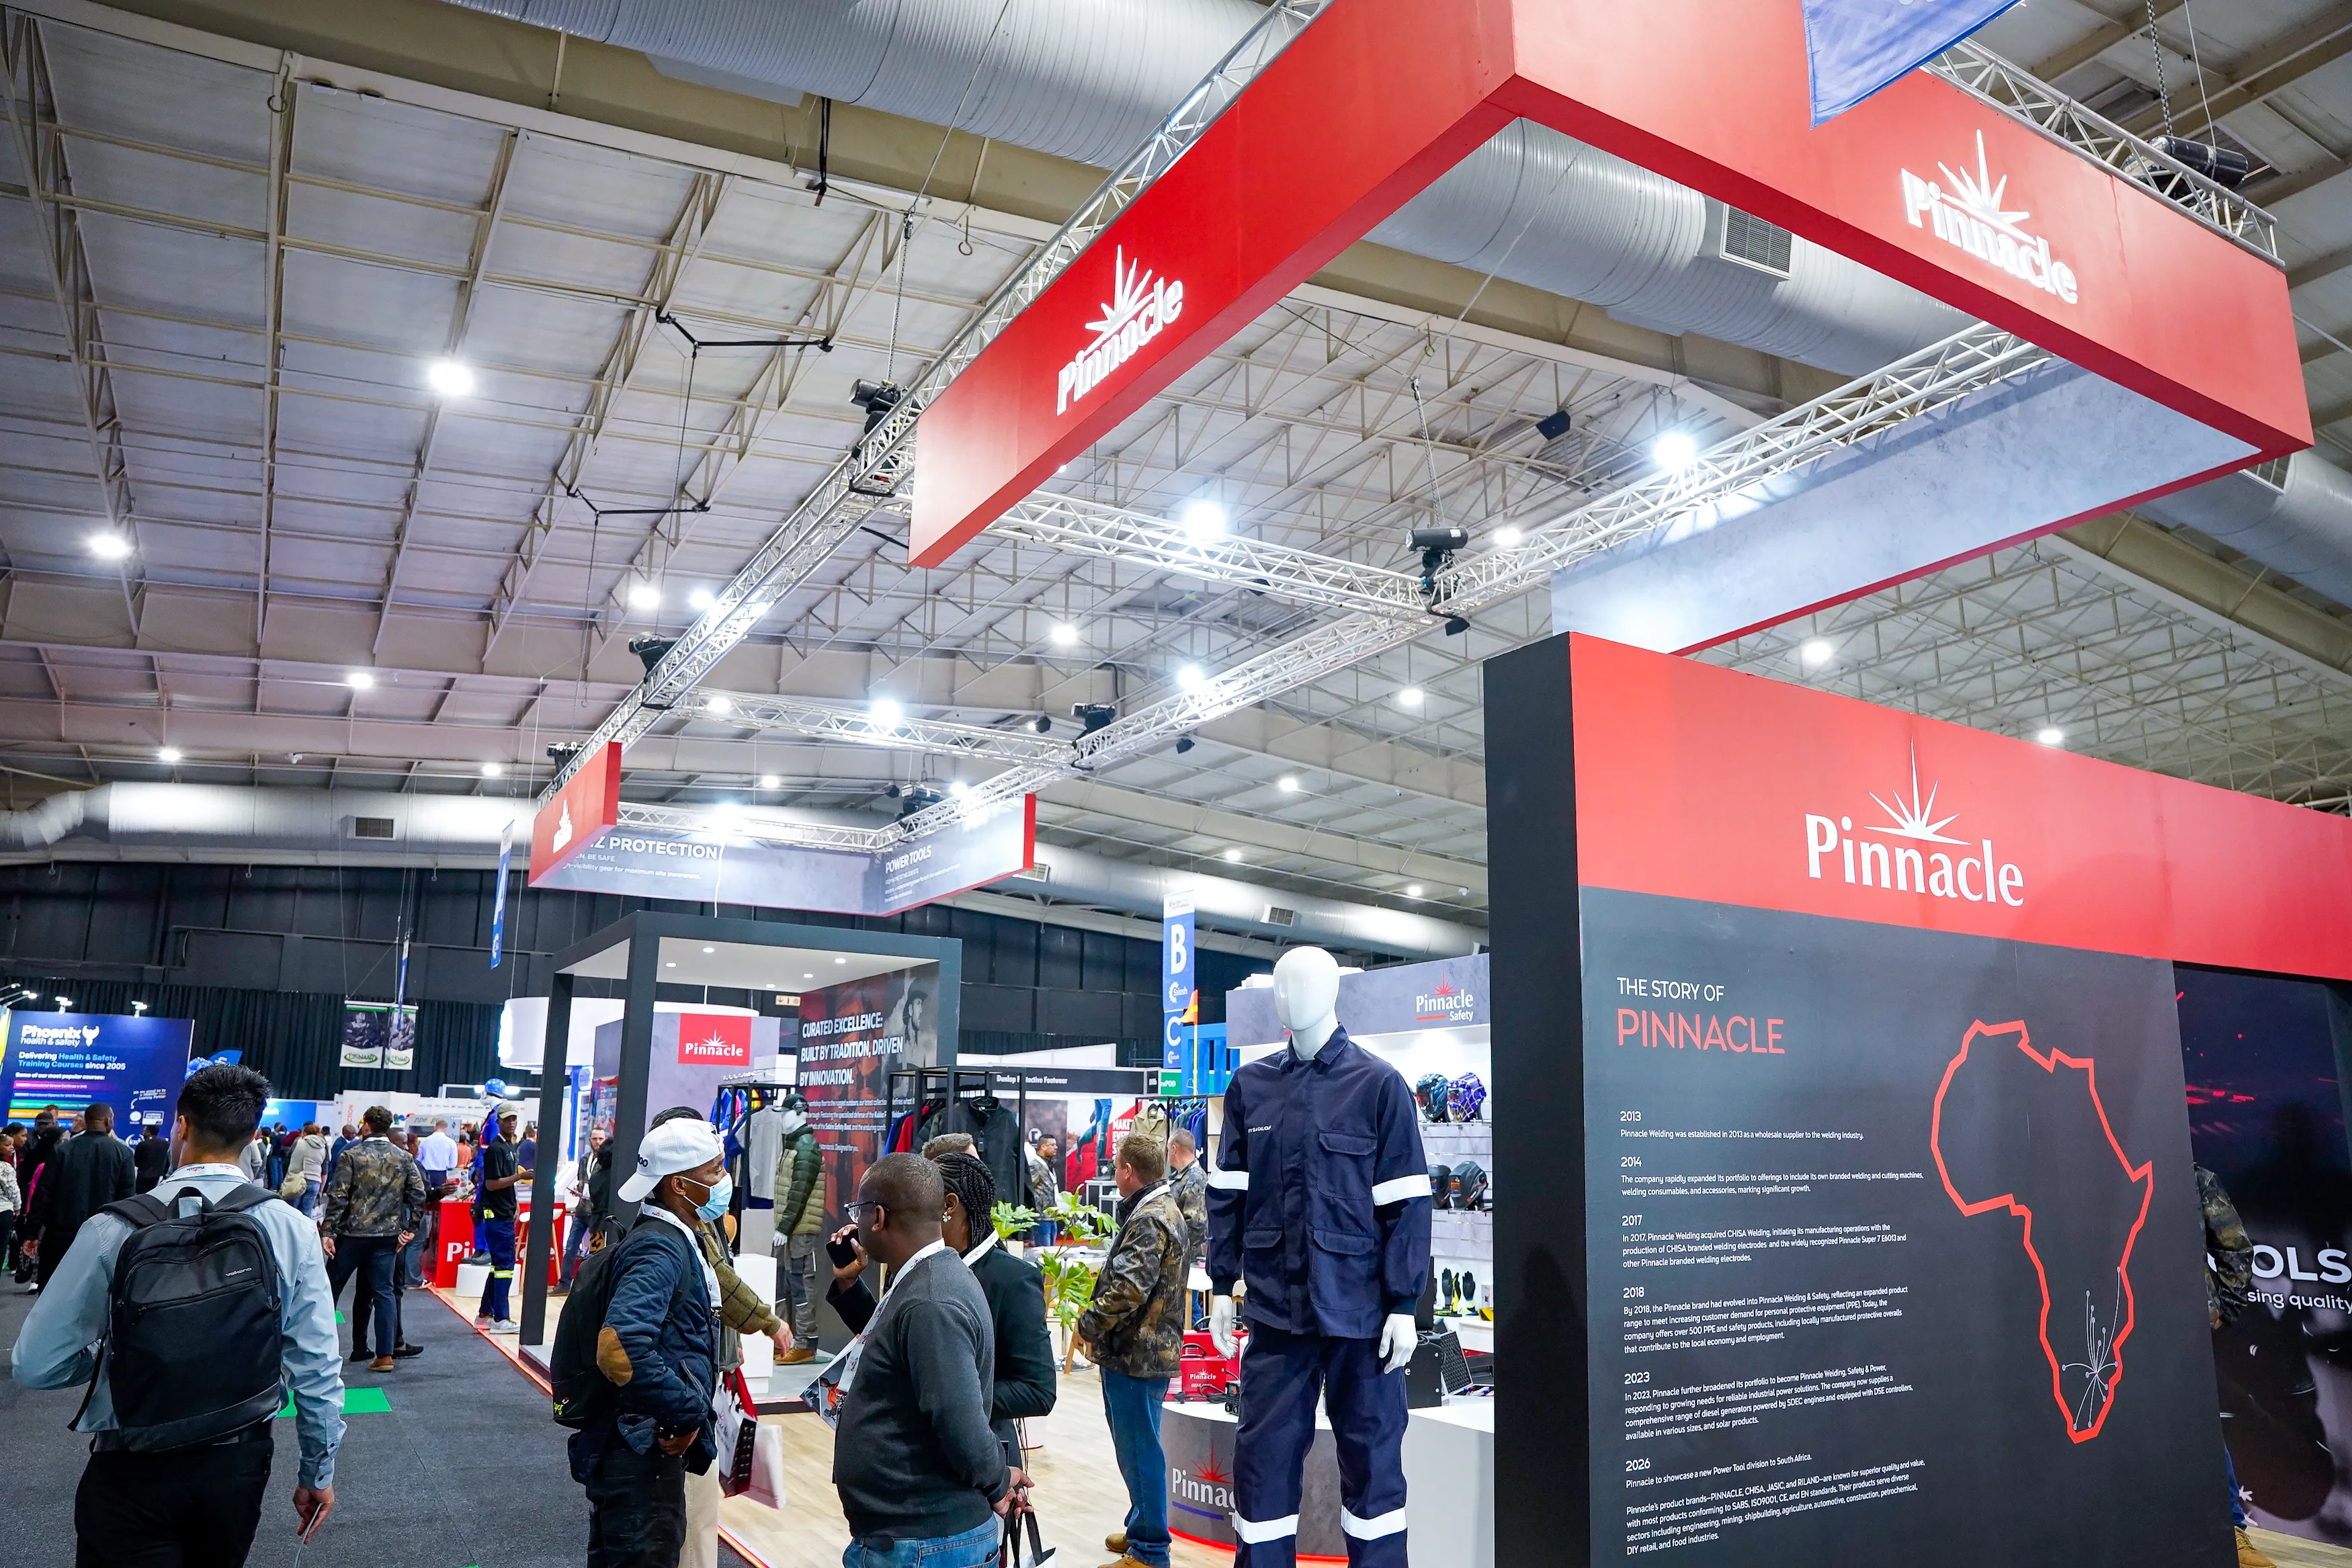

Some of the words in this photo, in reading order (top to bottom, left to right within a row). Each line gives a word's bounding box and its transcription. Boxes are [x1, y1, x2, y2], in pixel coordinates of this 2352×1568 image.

[1901, 168, 2078, 304] Pinnacle
[1056, 276, 1183, 417] Pinnacle
[609, 836, 718, 860] PROTECTION
[885, 854, 909, 873] POWER
[909, 844, 932, 865] TOOLS
[1805, 813, 2024, 907] Pinnacle
[1171, 924, 1187, 975] B
[1617, 977, 1648, 997] THE
[1651, 980, 1701, 1000] STORY
[1704, 984, 1725, 1002] OF
[1416, 989, 1474, 1012] Pinnacle
[1450, 1010, 1474, 1021] Safety
[22, 1025, 82, 1039] Phoenix
[802, 1020, 833, 1038] CURATED
[833, 1012, 883, 1033] EXCELLENCE:
[1166, 1016, 1181, 1047] C
[1618, 1008, 1786, 1054] PINNACLE
[21, 1037, 47, 1045] health
[55, 1039, 81, 1047] safety
[685, 1042, 744, 1057] Pinnacle
[800, 1047, 820, 1062] BUILT
[820, 1045, 830, 1060] BY
[829, 1040, 872, 1059] TRADITION,
[872, 1036, 904, 1055] DRIVEN
[19, 1051, 57, 1061] Delivering
[58, 1052, 84, 1061] Health
[92, 1054, 118, 1063] Safety
[19, 1059, 50, 1070] Training
[51, 1061, 84, 1069] Courses
[85, 1061, 106, 1070] since
[800, 1072, 809, 1086] BY
[809, 1068, 854, 1086] INNOVATION.
[997, 1075, 1016, 1084] Dunlop
[1113, 1119, 1130, 1130] MAKE
[1620, 1110, 1642, 1123] 2013
[1620, 1129, 1648, 1137] Pinnacle
[1648, 1129, 1674, 1139] Welding
[1687, 1130, 1721, 1138] established
[1722, 1130, 1728, 1138] in
[1728, 1130, 1743, 1138] 2013
[1754, 1130, 1782, 1139] wholesale
[1782, 1131, 1805, 1140] supplier
[1811, 1131, 1821, 1139] the
[1820, 1131, 1842, 1141] welding
[1841, 1131, 1864, 1141] industry.
[1621, 1156, 1642, 1168] 2014
[1621, 1175, 1634, 1183] The
[1634, 1176, 1664, 1185] company
[1665, 1174, 1686, 1184] rapidly
[1687, 1174, 1716, 1184] expanded
[1717, 1174, 1725, 1182] its
[1725, 1173, 1750, 1184] portfolio
[1750, 1174, 1757, 1182] to
[1757, 1173, 1782, 1183] offerings
[1789, 1172, 1810, 1180] include
[1829, 1172, 1851, 1180] branded
[1851, 1172, 1872, 1181] welding
[1871, 1172, 1881, 1180] and
[1881, 1172, 1899, 1180] cutting
[1899, 1171, 1924, 1179] machines,
[1621, 1187, 1647, 1198] welding
[1647, 1186, 1690, 1195] consumables,
[1689, 1186, 1702, 1194] and
[1702, 1186, 1737, 1194] accessories,
[1737, 1185, 1761, 1195] marking
[1761, 1184, 1790, 1194] significant
[1790, 1184, 1811, 1194] growth.
[1622, 1214, 1642, 1227] 2017
[1622, 1234, 1629, 1242] In
[1630, 1233, 1647, 1242] 2017,
[1647, 1232, 1675, 1242] Pinnacle
[1675, 1231, 1700, 1242] Welding
[1700, 1229, 1726, 1241] acquired
[1727, 1229, 1747, 1238] CHISA
[1747, 1228, 1772, 1238] Welding,
[1772, 1227, 1796, 1237] initiating
[1804, 1225, 1843, 1235] manufacturing
[1843, 1224, 1870, 1234] operations
[1870, 1223, 1882, 1231] with
[1622, 1246, 1658, 1257] production
[1658, 1245, 1665, 1254] of
[1666, 1244, 1687, 1253] CHISA
[1687, 1243, 1713, 1252] branded
[1713, 1242, 1736, 1252] welding
[1737, 1240, 1767, 1250] electrodes
[1769, 1239, 1780, 1248] and
[1780, 1239, 1790, 1248] the
[1790, 1238, 1809, 1248] widely
[1809, 1237, 1838, 1247] recognized
[1839, 1235, 1861, 1244] Pinnacle
[1861, 1235, 1877, 1244] Super
[1876, 1234, 1881, 1243] 7
[1881, 1233, 1897, 1242] E6013
[1896, 1233, 1906, 1242] and
[1622, 1259, 1640, 1268] other
[1641, 1258, 1669, 1267] Pinnacle
[1669, 1256, 1695, 1266] branded
[1695, 1255, 1720, 1265] welding
[1720, 1253, 1752, 1263] electrodes.
[2208, 1244, 2352, 1284] OLS
[1623, 1286, 1645, 1299] 2018
[2289, 1294, 2352, 1315] quality
[1624, 1372, 1650, 1385] 2023
[1626, 1458, 1651, 1472] 2026
[1626, 1477, 1654, 1489] Pinnacle
[1655, 1476, 1663, 1484] to
[1663, 1472, 1694, 1483] showcase
[1699, 1469, 1712, 1477] new
[1713, 1466, 1732, 1475] Power
[1732, 1462, 1746, 1472] Tool
[1746, 1460, 1769, 1470] division
[1769, 1458, 1776, 1467] to
[1776, 1455, 1794, 1465] South
[1794, 1453, 1812, 1463] Africa.
[1172, 1467, 1236, 1510] Pinnac
